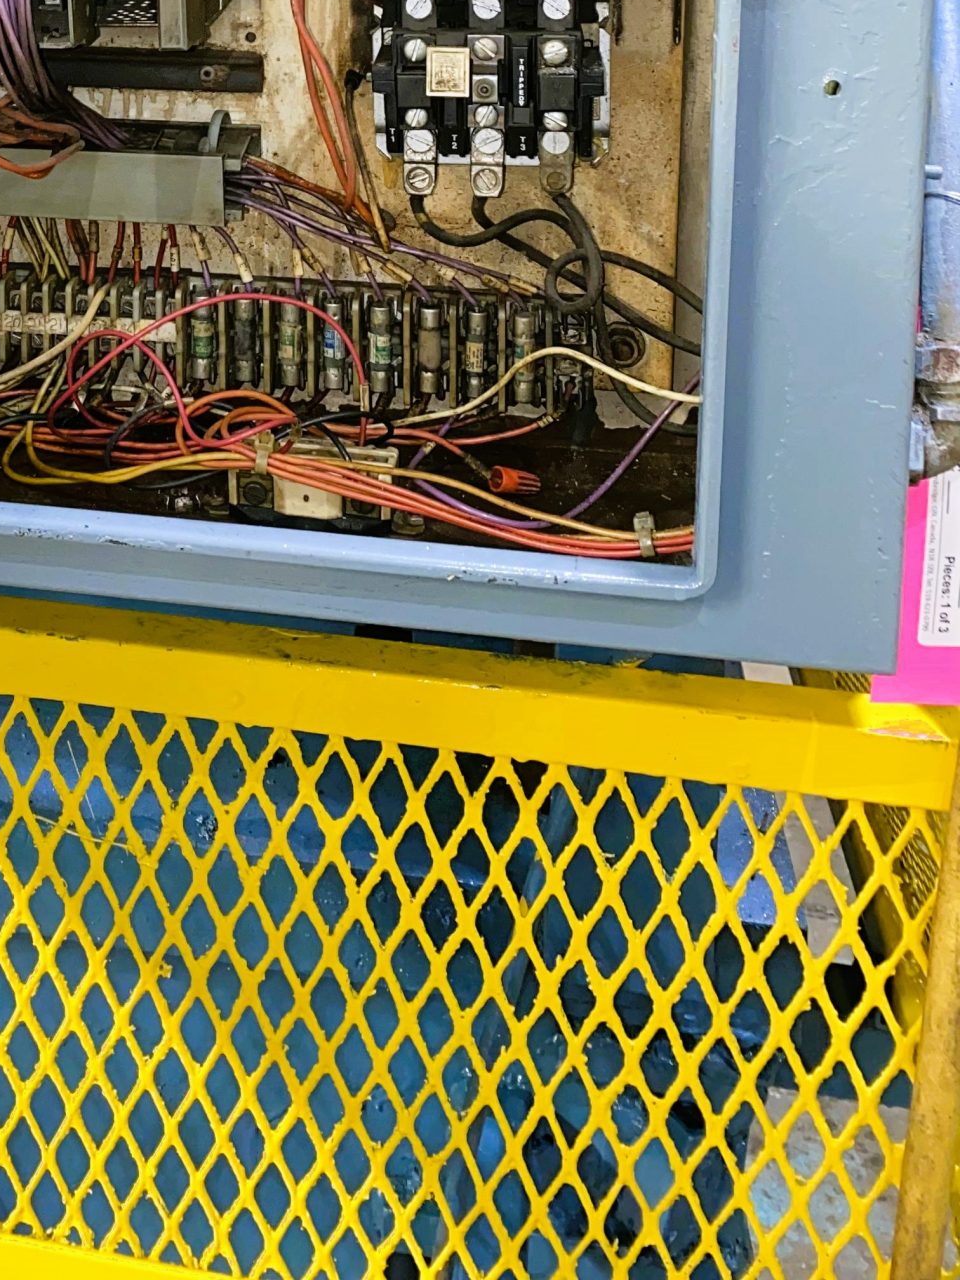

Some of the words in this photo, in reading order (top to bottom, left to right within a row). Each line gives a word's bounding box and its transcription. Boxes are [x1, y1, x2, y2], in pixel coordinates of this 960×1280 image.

[518, 58, 526, 101] TRIPPED
[49, 317, 63, 330] 21
[942, 556, 956, 598] Pieces:
[938, 612, 951, 623] of
[937, 625, 949, 634] 3
